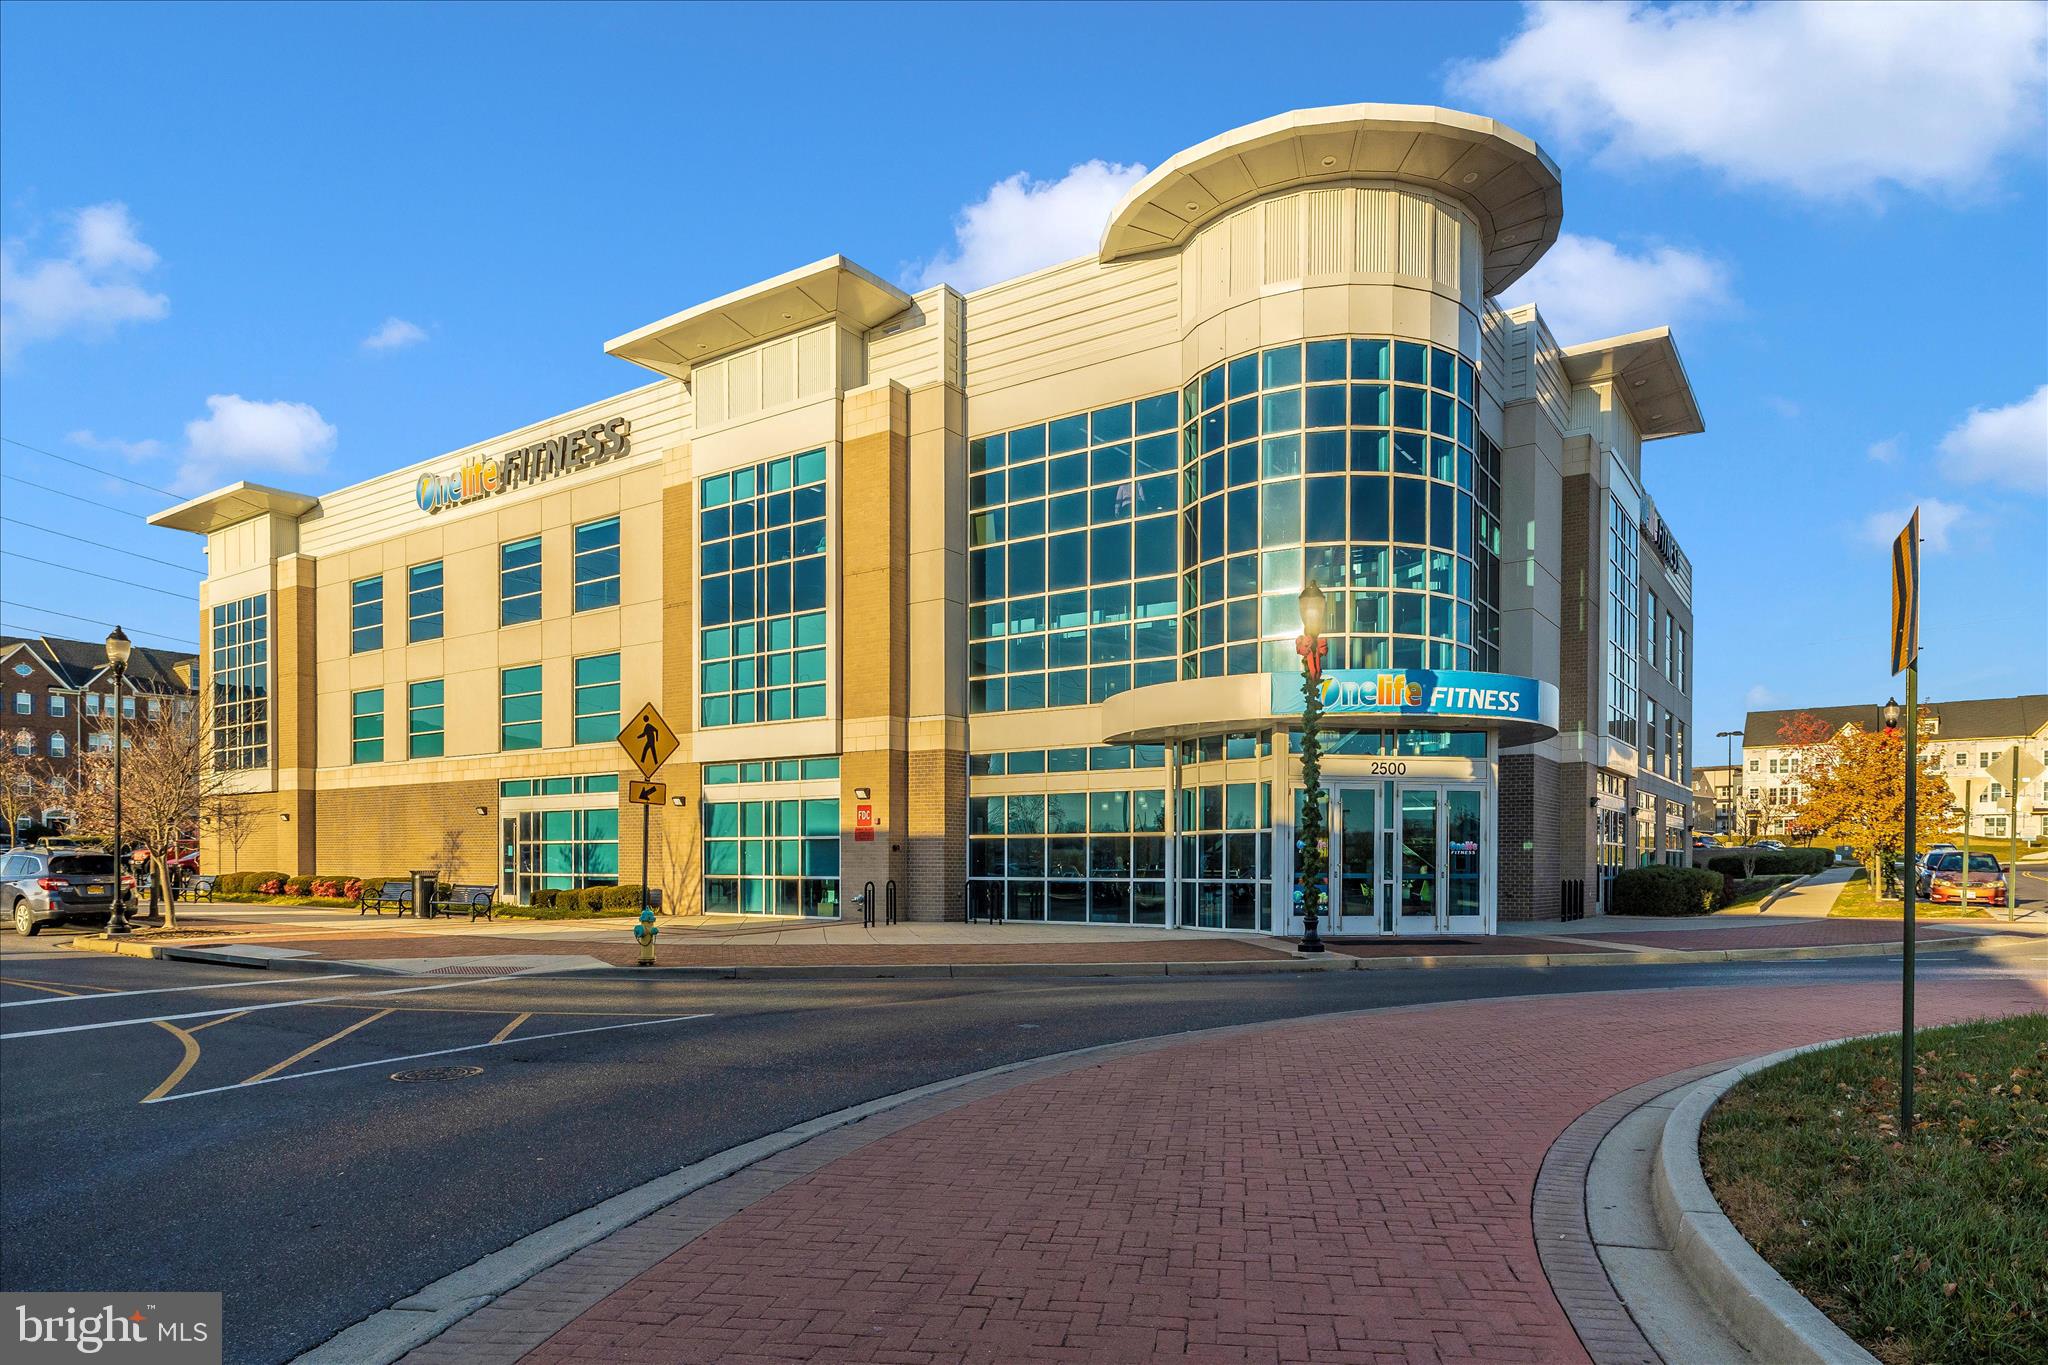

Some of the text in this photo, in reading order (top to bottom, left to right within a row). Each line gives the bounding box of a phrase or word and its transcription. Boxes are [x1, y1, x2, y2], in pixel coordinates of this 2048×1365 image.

[416, 417, 626, 512] Onelife FITNESS
[1320, 673, 1520, 712] Onelife FITNESS
[1371, 762, 1407, 776] 2500
[858, 810, 871, 820] FDC
